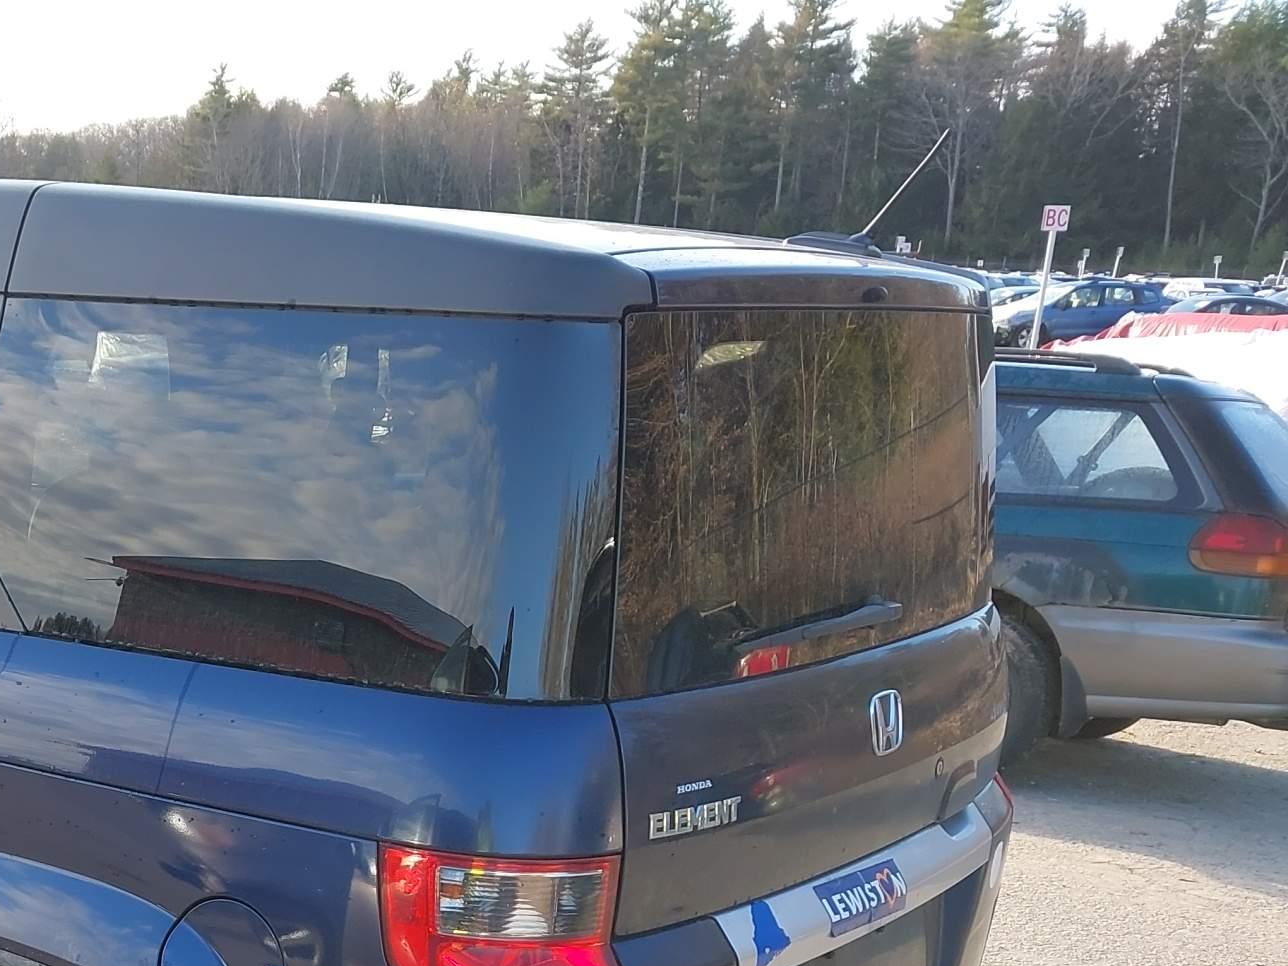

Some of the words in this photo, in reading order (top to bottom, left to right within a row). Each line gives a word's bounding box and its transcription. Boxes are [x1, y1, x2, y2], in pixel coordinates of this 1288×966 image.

[1045, 208, 1069, 227] BC
[676, 779, 713, 795] HONDA
[649, 795, 742, 840] ELEMENT
